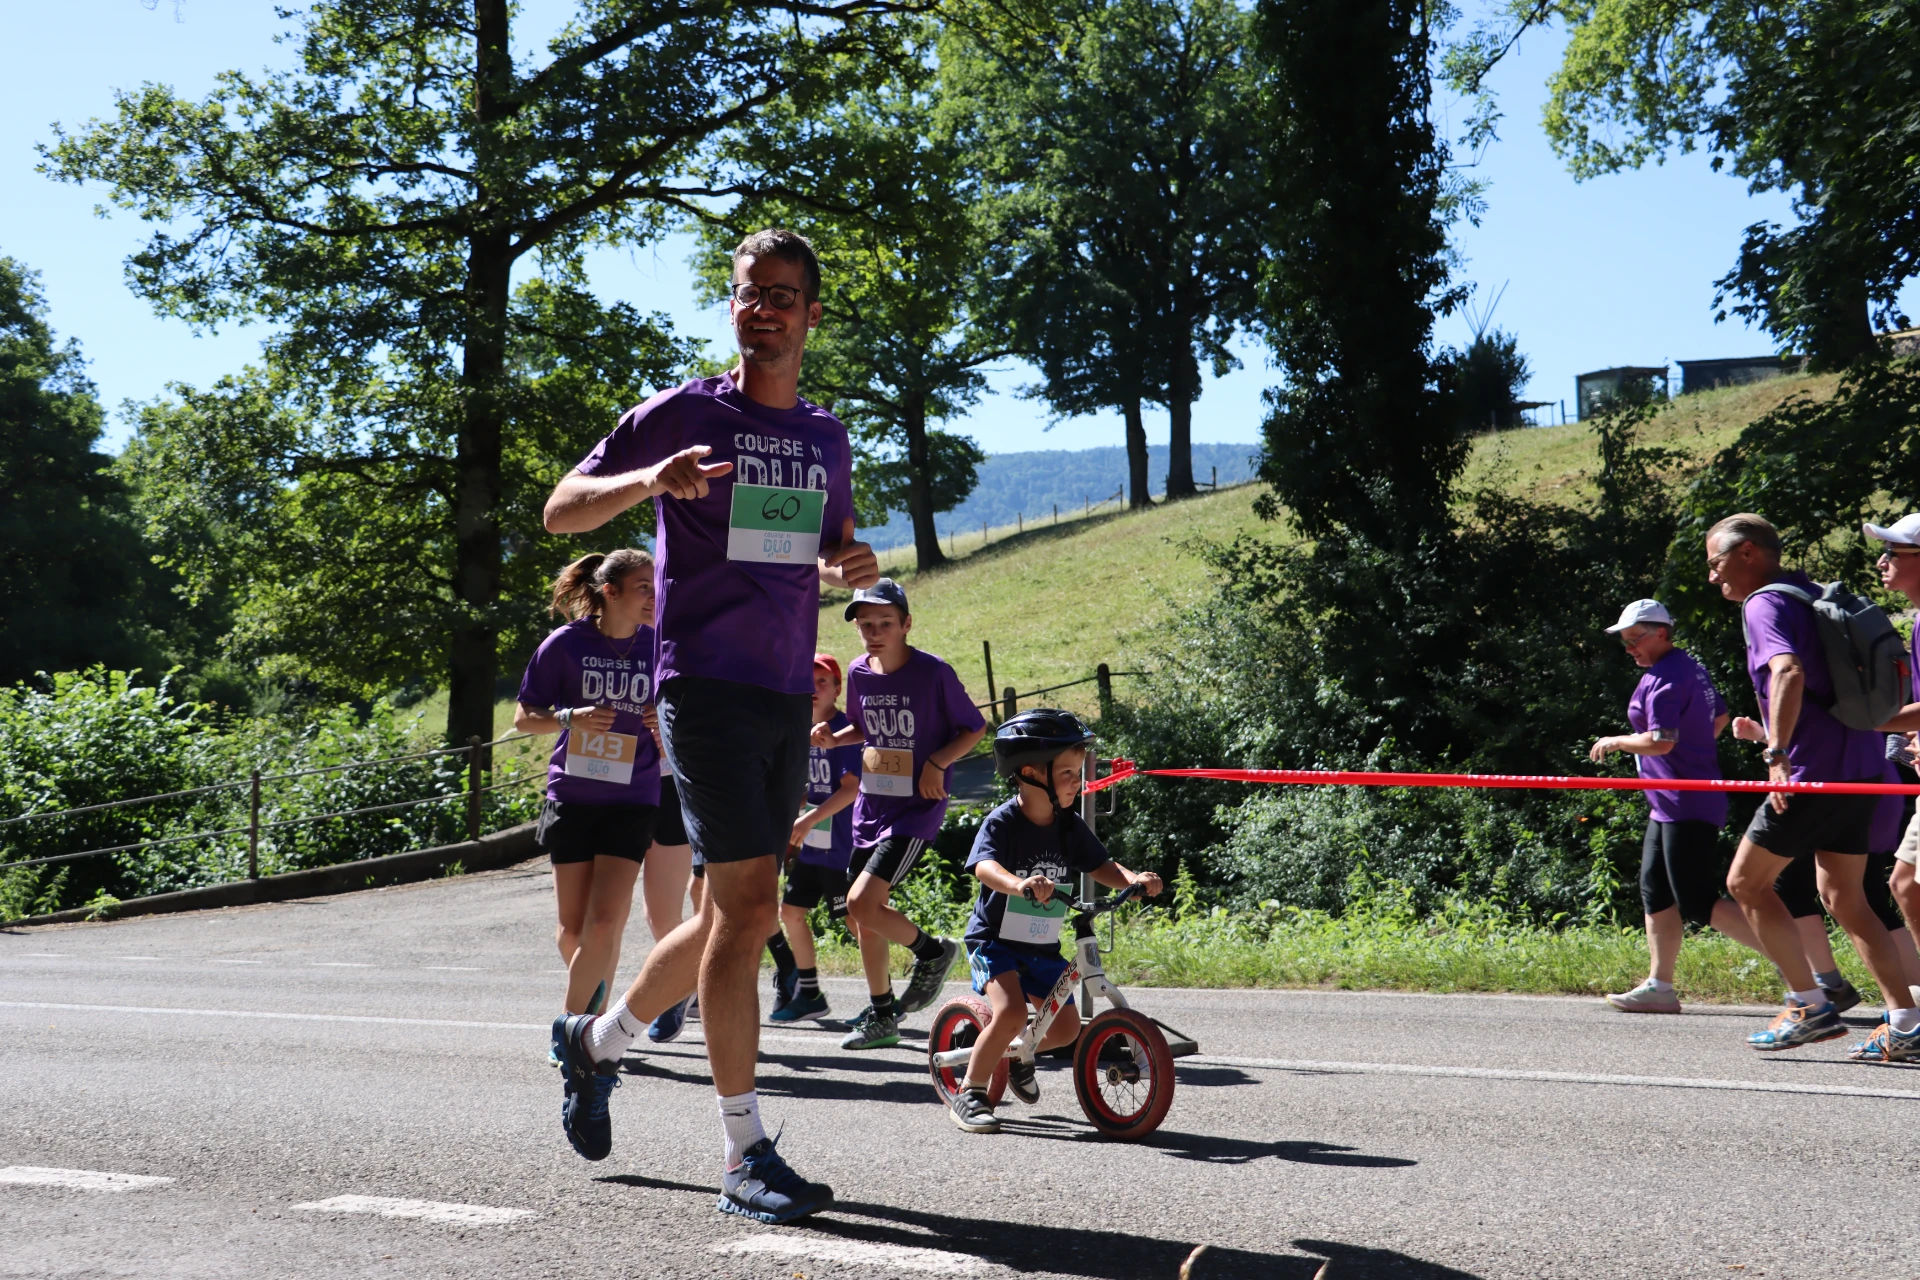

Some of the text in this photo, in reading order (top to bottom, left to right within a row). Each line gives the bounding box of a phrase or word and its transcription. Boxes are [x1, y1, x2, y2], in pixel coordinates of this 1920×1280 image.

[734, 433, 804, 457] COURSE
[762, 492, 801, 522] 60
[763, 538, 792, 554] DUO
[582, 656, 631, 669] COURSE
[582, 670, 650, 704] DUO
[863, 709, 915, 737] DUO
[581, 732, 624, 759] 143
[808, 758, 831, 784] UO
[871, 753, 900, 773] 143
[1031, 962, 1078, 1037] MUSTANG
